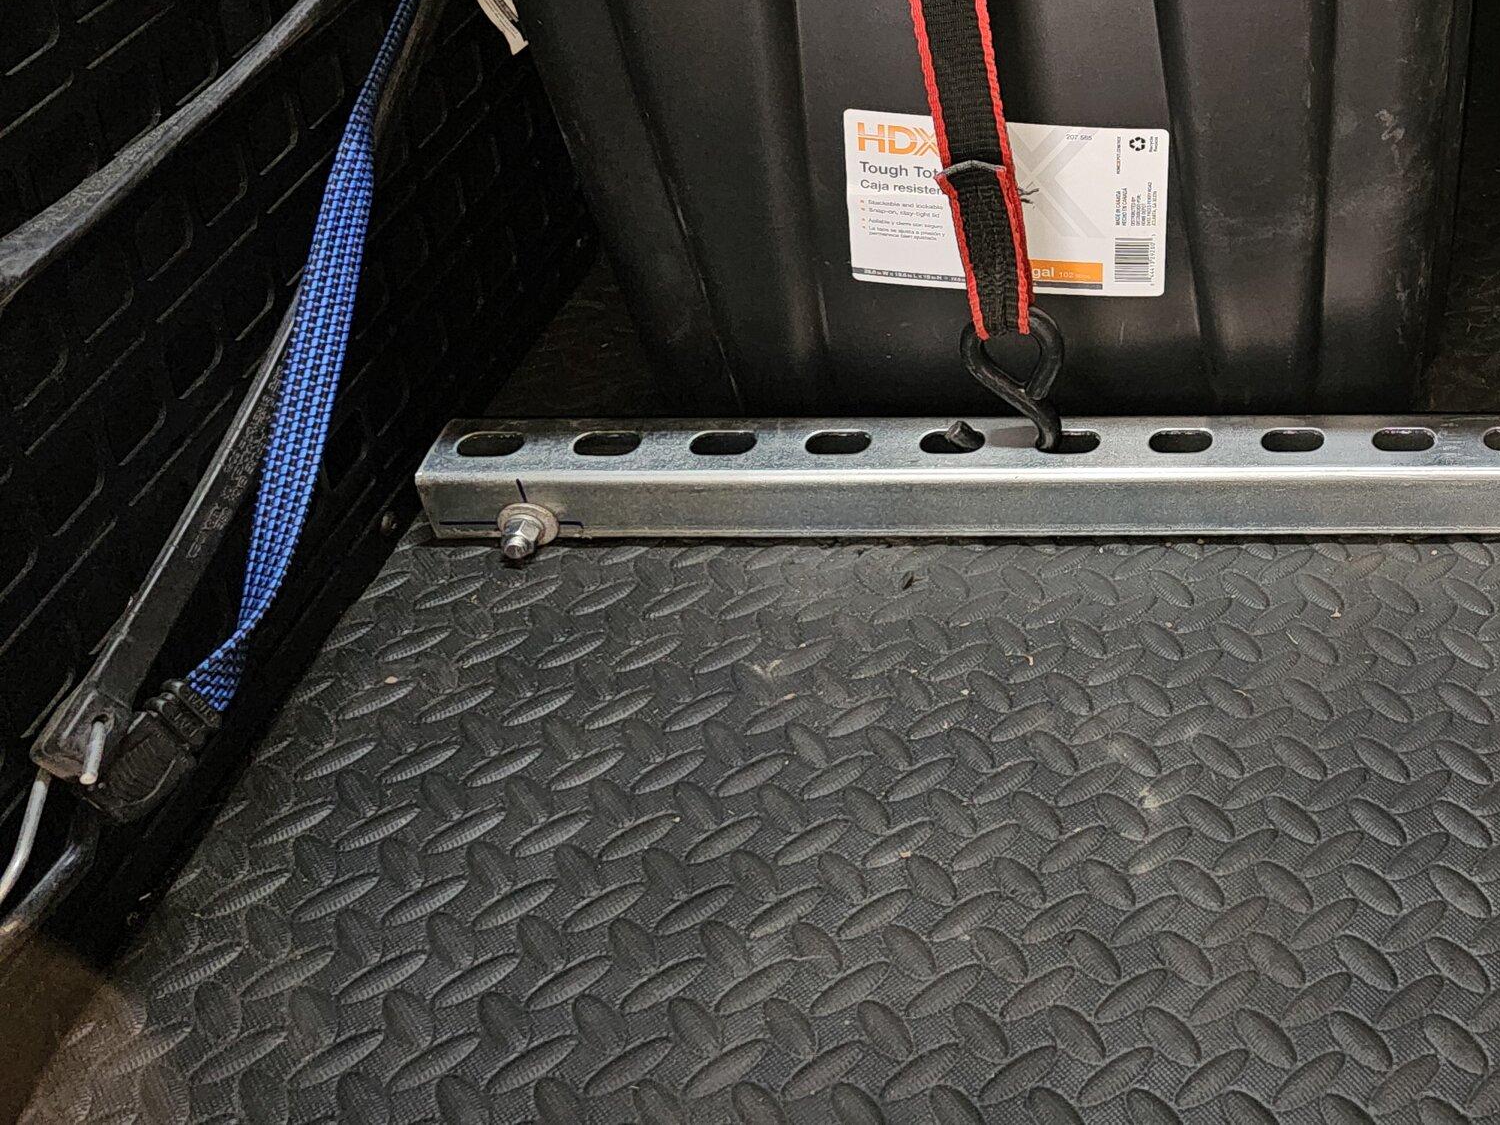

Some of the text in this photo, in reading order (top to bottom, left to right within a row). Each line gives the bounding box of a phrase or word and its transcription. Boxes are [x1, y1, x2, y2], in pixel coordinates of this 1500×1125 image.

[857, 122, 940, 156] HDX
[860, 161, 939, 179] Tough Tot
[860, 179, 889, 192] Caja
[1032, 267, 1054, 279] gal
